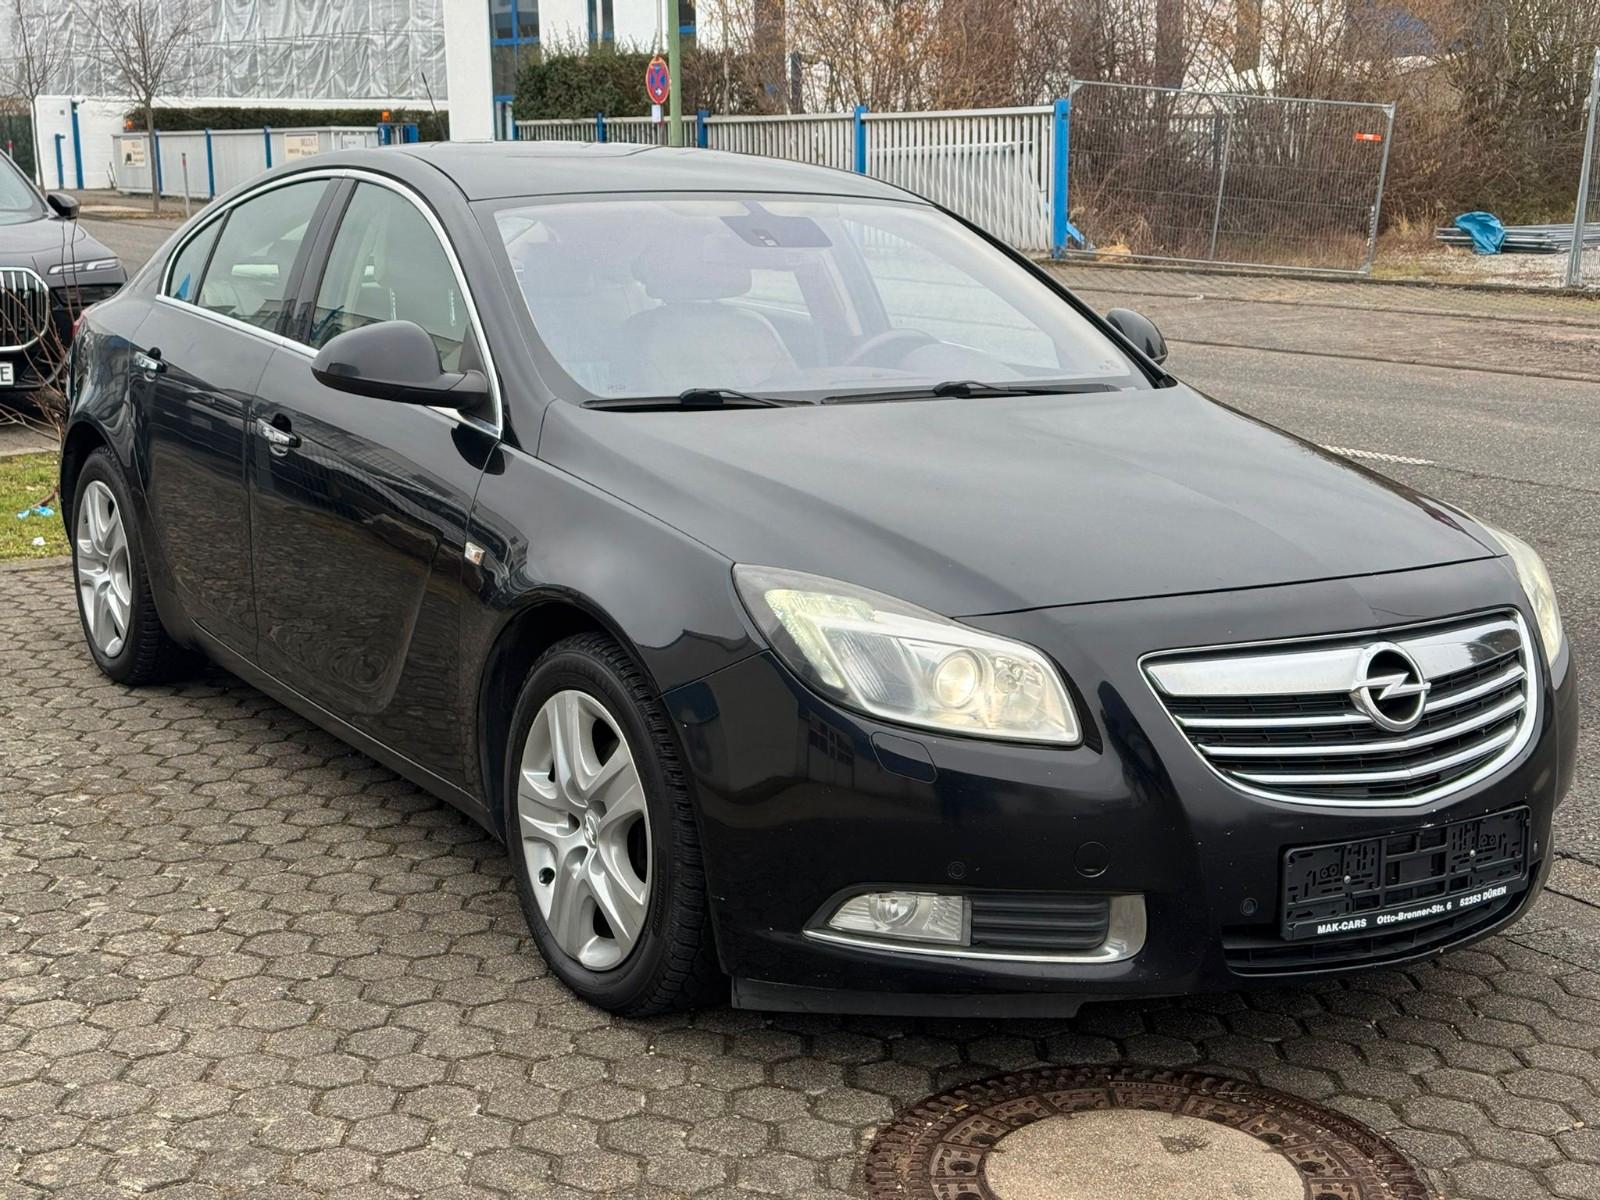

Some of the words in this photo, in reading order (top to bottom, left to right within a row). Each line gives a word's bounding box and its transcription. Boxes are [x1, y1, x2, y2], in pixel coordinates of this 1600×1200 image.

[1317, 919, 1367, 934] MAK-CARS
[1376, 904, 1445, 924] Otto-Brenner-Str.
[1446, 902, 1452, 910] 6
[1459, 894, 1482, 907] 52353
[1482, 886, 1507, 901] DÜREN
